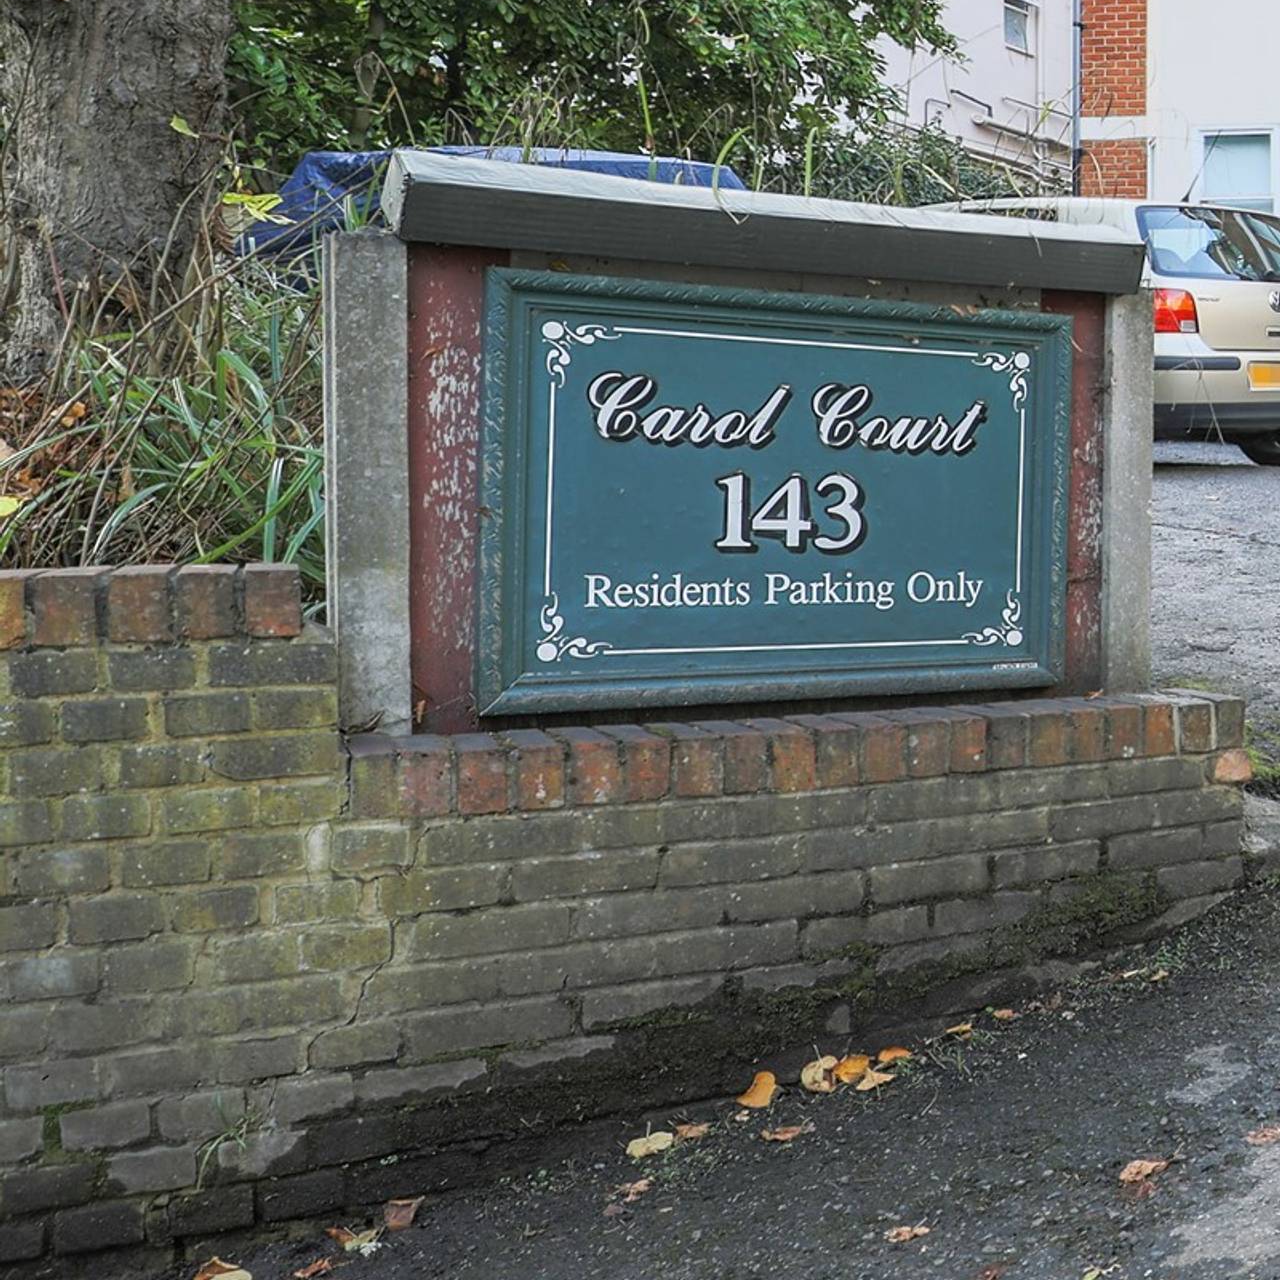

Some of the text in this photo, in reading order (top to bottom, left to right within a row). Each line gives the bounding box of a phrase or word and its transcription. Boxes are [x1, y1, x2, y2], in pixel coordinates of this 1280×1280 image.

[587, 372, 988, 455] Carol Court
[714, 470, 866, 554] 143
[584, 570, 984, 610] Residents Parking Only
